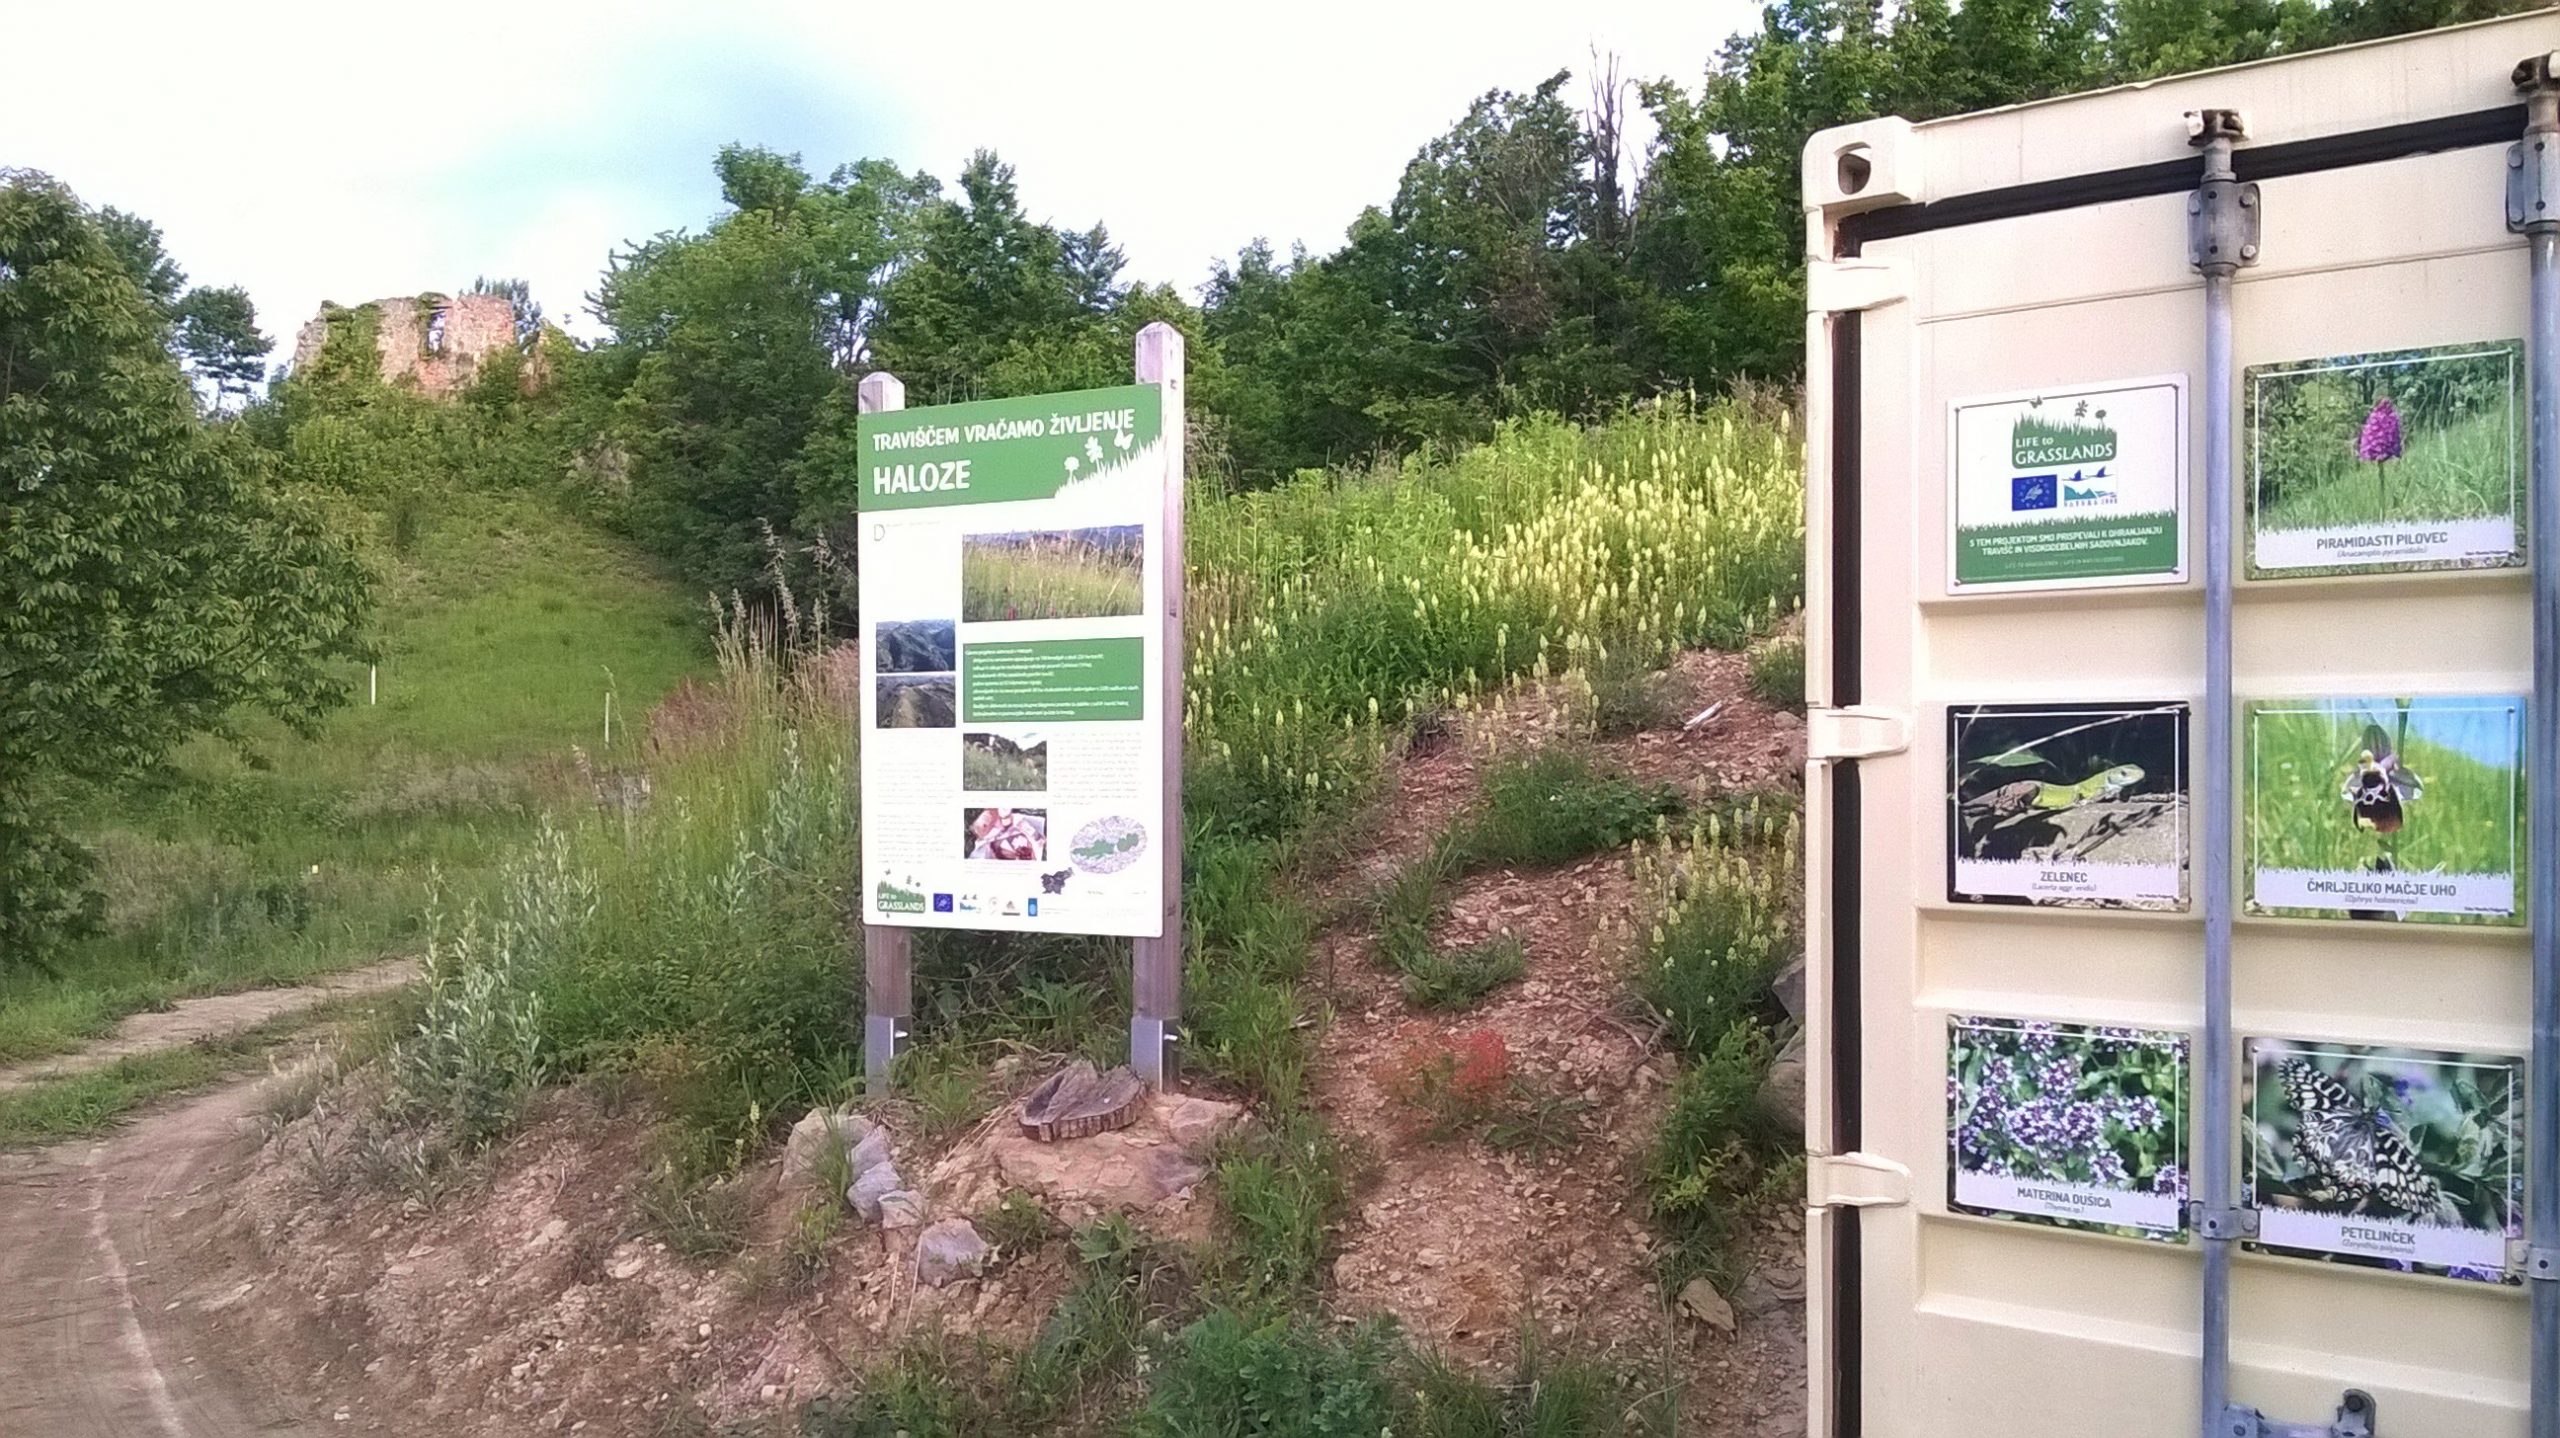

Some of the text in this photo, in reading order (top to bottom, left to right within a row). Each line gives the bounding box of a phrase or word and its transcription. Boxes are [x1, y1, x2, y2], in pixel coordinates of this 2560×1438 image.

[873, 408, 1135, 452] TRAVIŠČEM VRAČAMO ŽIVLJENJE
[2015, 436, 2054, 448] LIFE to
[2015, 443, 2113, 465] GRASSLANDS
[873, 459, 972, 495] HALOZE
[1969, 526, 2162, 548] S TEM PROJEKTOM SMO PRISPEVALI K OHRANJANJU
[2316, 532, 2448, 550] PIRAMIDASTI PILOVEC
[2014, 545, 2023, 554] IN
[2023, 540, 2089, 553] VISOKODEBELNIH
[2040, 871, 2088, 883] ZELENEC
[2307, 878, 2456, 896] ČMRLJELIKO MAČJE UHO
[878, 901, 925, 912] GRASSLANDS
[2017, 1187, 2112, 1209] MATERINA DUŠICA
[2341, 1226, 2416, 1245] PETELINČEK
